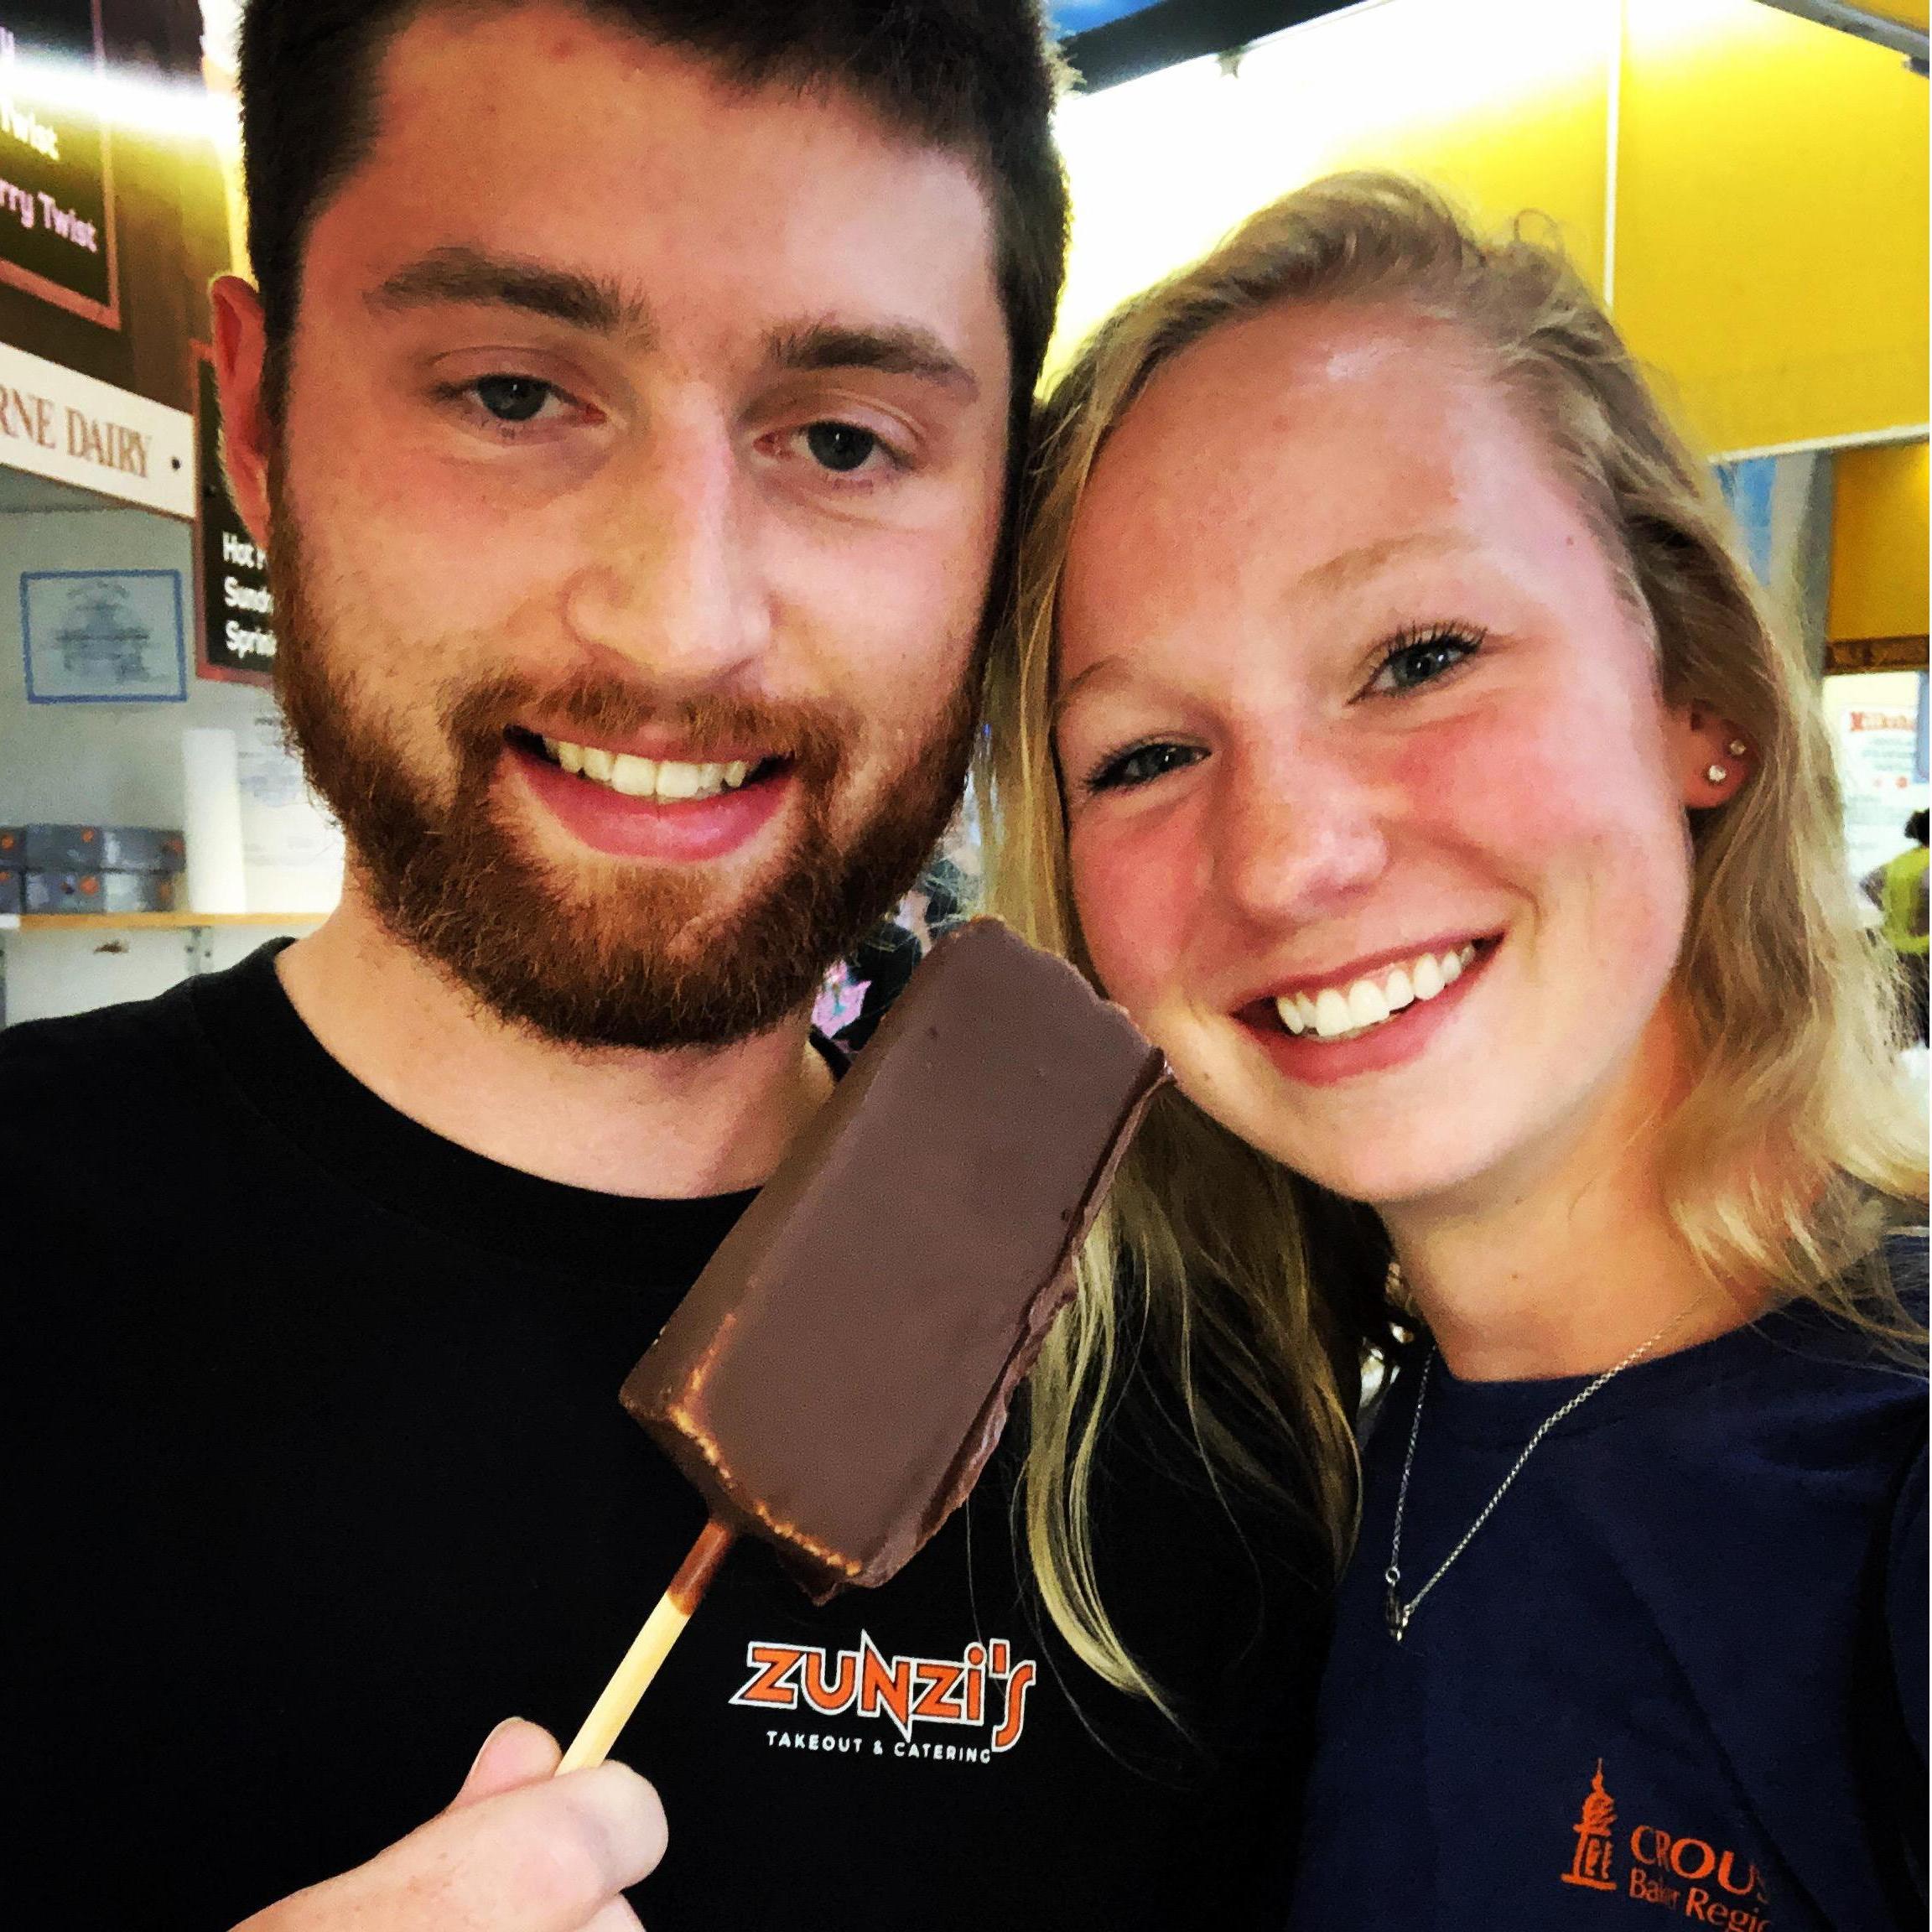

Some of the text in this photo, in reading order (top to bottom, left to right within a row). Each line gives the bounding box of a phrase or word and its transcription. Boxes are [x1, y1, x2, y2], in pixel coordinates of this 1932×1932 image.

[38, 190, 97, 253] Twist
[65, 406, 152, 478] DAIRY
[222, 531, 255, 569] Hot
[766, 1730, 990, 1764] TAKEOUT & CATERING
